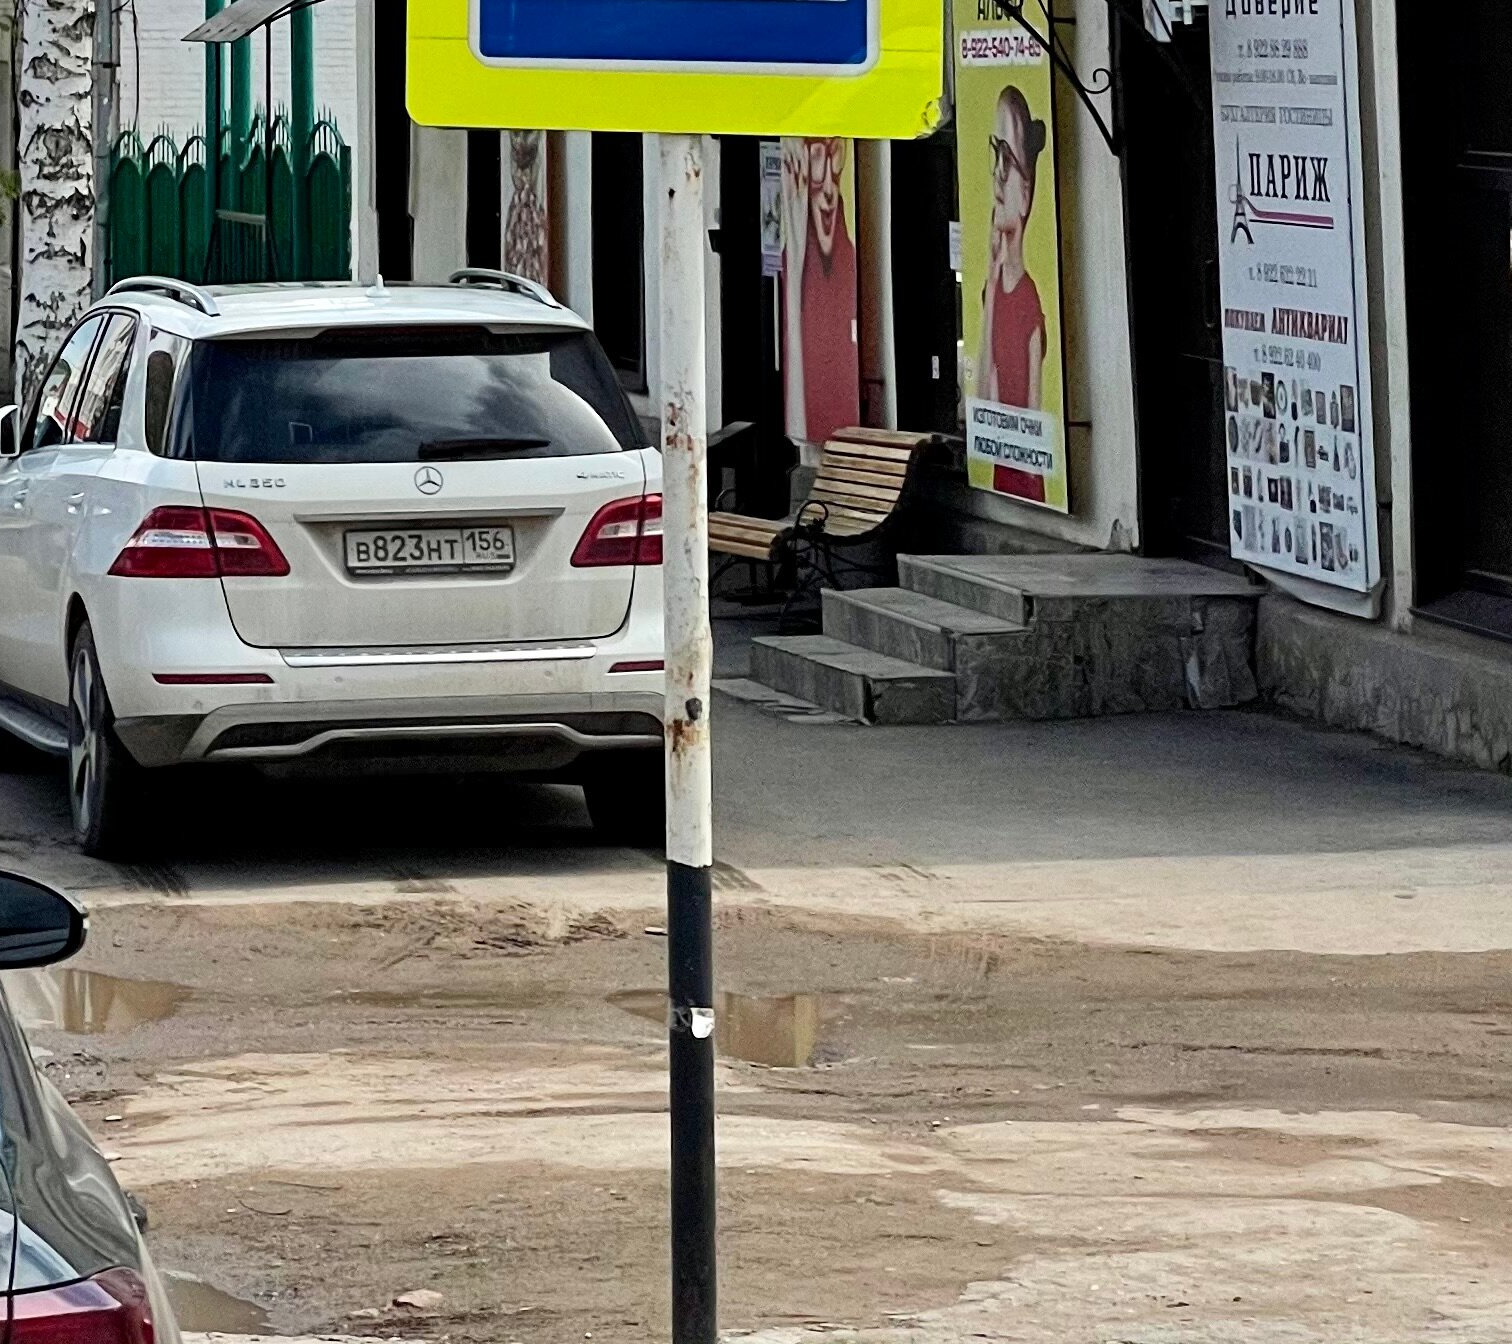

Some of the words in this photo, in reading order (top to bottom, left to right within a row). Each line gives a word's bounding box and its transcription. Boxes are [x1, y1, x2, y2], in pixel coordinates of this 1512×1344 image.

[1248, 152, 1331, 203] ПАРИЖ
[355, 534, 459, 562] В823НТ
[464, 530, 506, 553] 156
